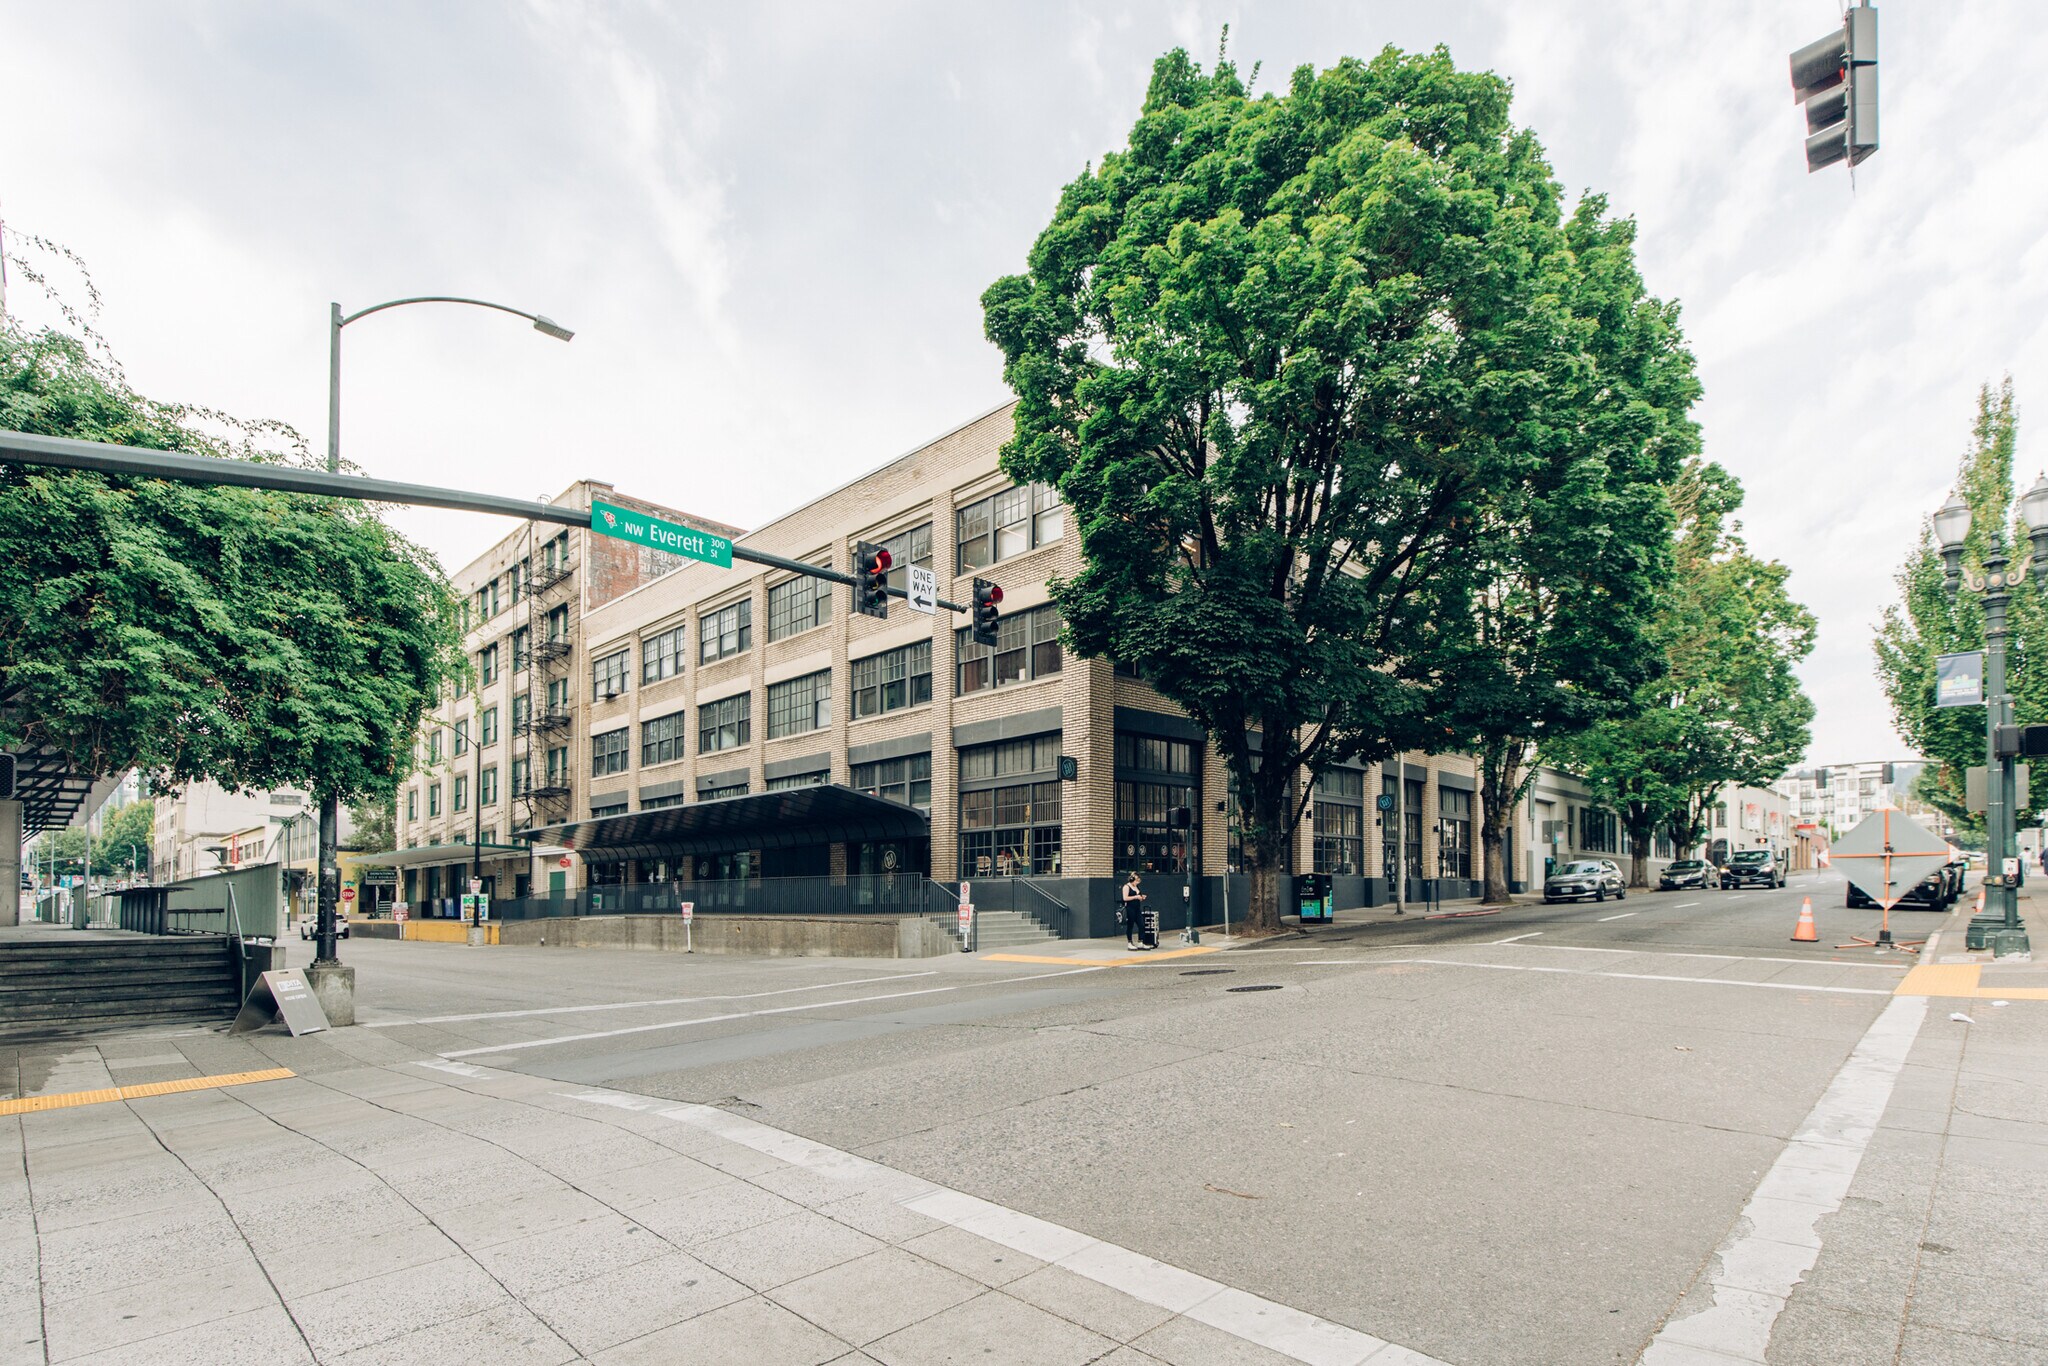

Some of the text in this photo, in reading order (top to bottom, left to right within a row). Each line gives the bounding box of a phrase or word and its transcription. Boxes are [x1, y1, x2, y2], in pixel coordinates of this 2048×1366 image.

[625, 521, 726, 555] NW Everett 300
[710, 549, 718, 559] St
[913, 569, 932, 584] ONE
[913, 581, 932, 595] WAY
